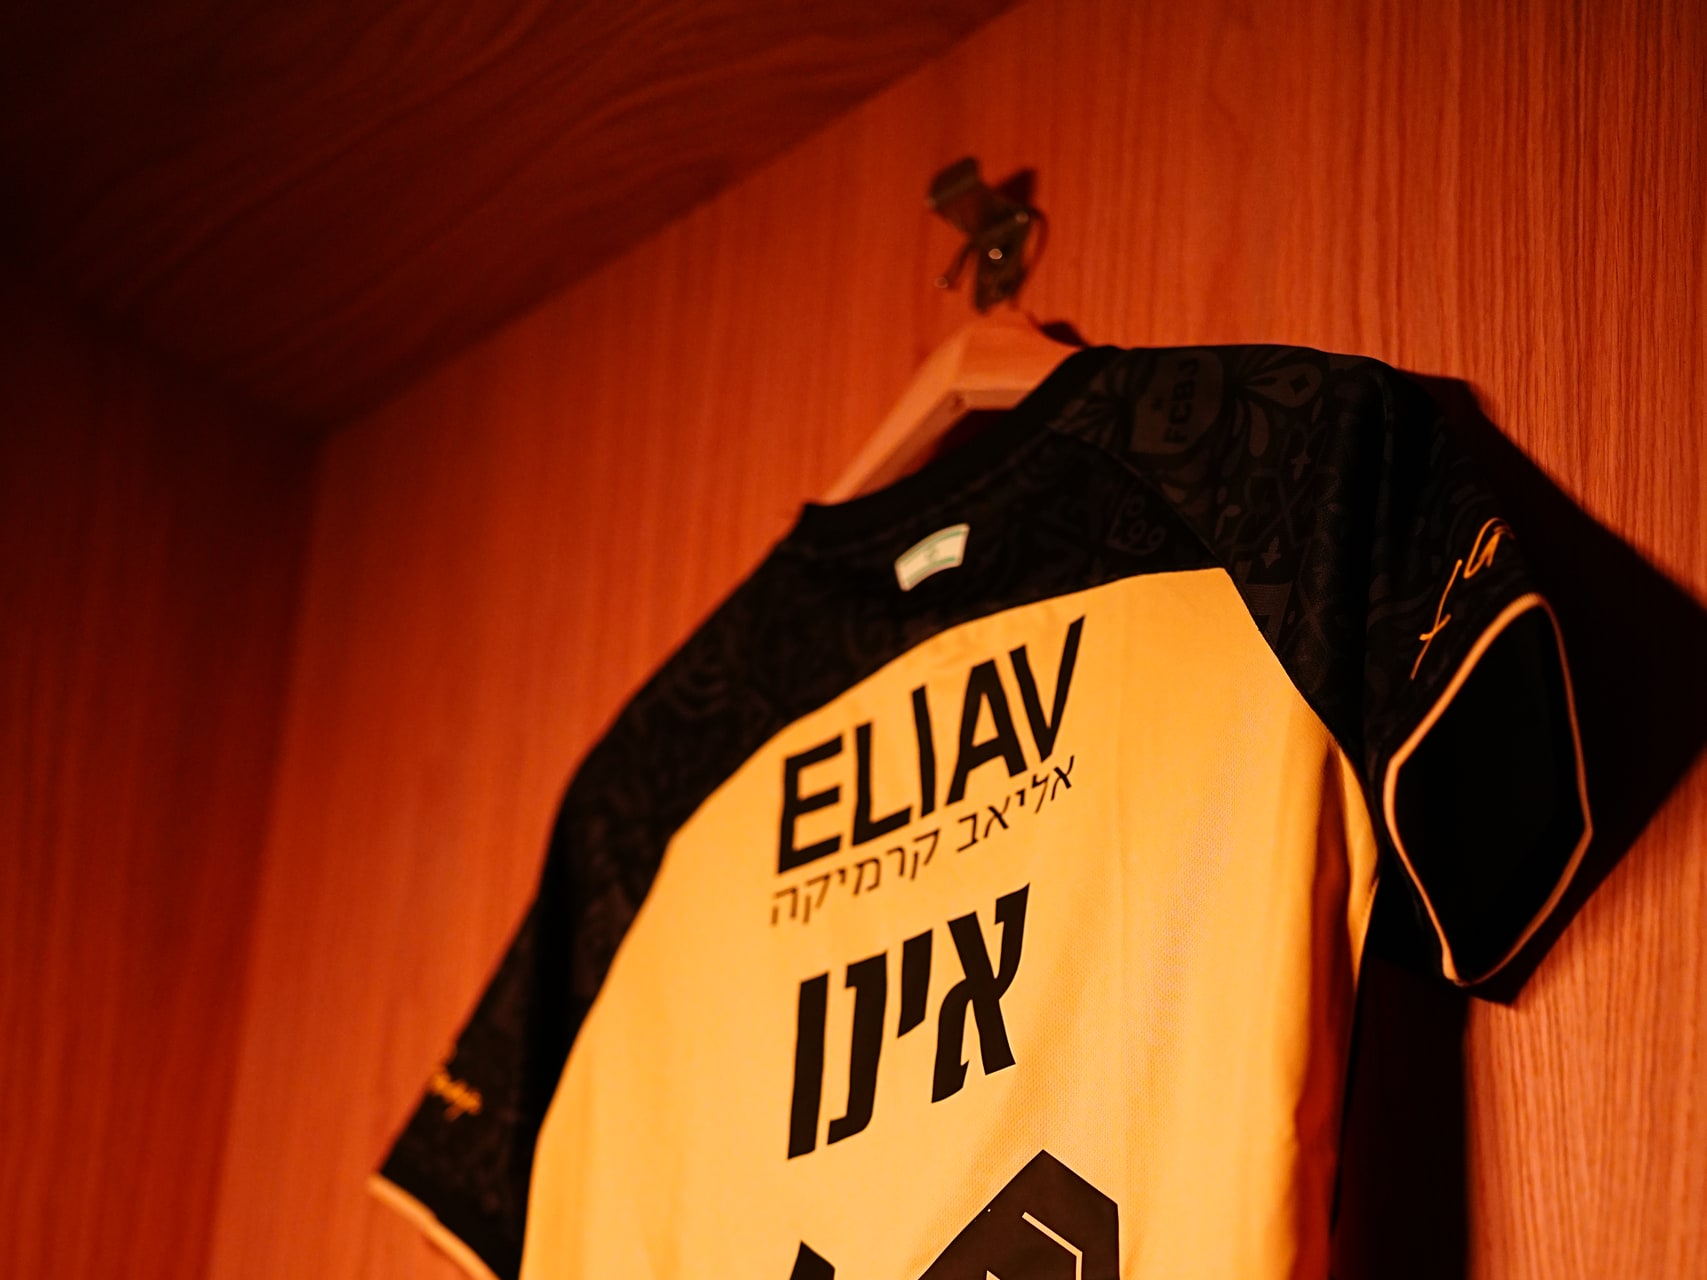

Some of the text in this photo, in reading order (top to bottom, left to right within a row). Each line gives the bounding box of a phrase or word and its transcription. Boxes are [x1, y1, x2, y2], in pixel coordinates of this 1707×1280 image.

[772, 755, 1075, 926] אליאב קרמיקה
[777, 615, 1085, 874] ELIAV
[787, 883, 1030, 1160] אינו
